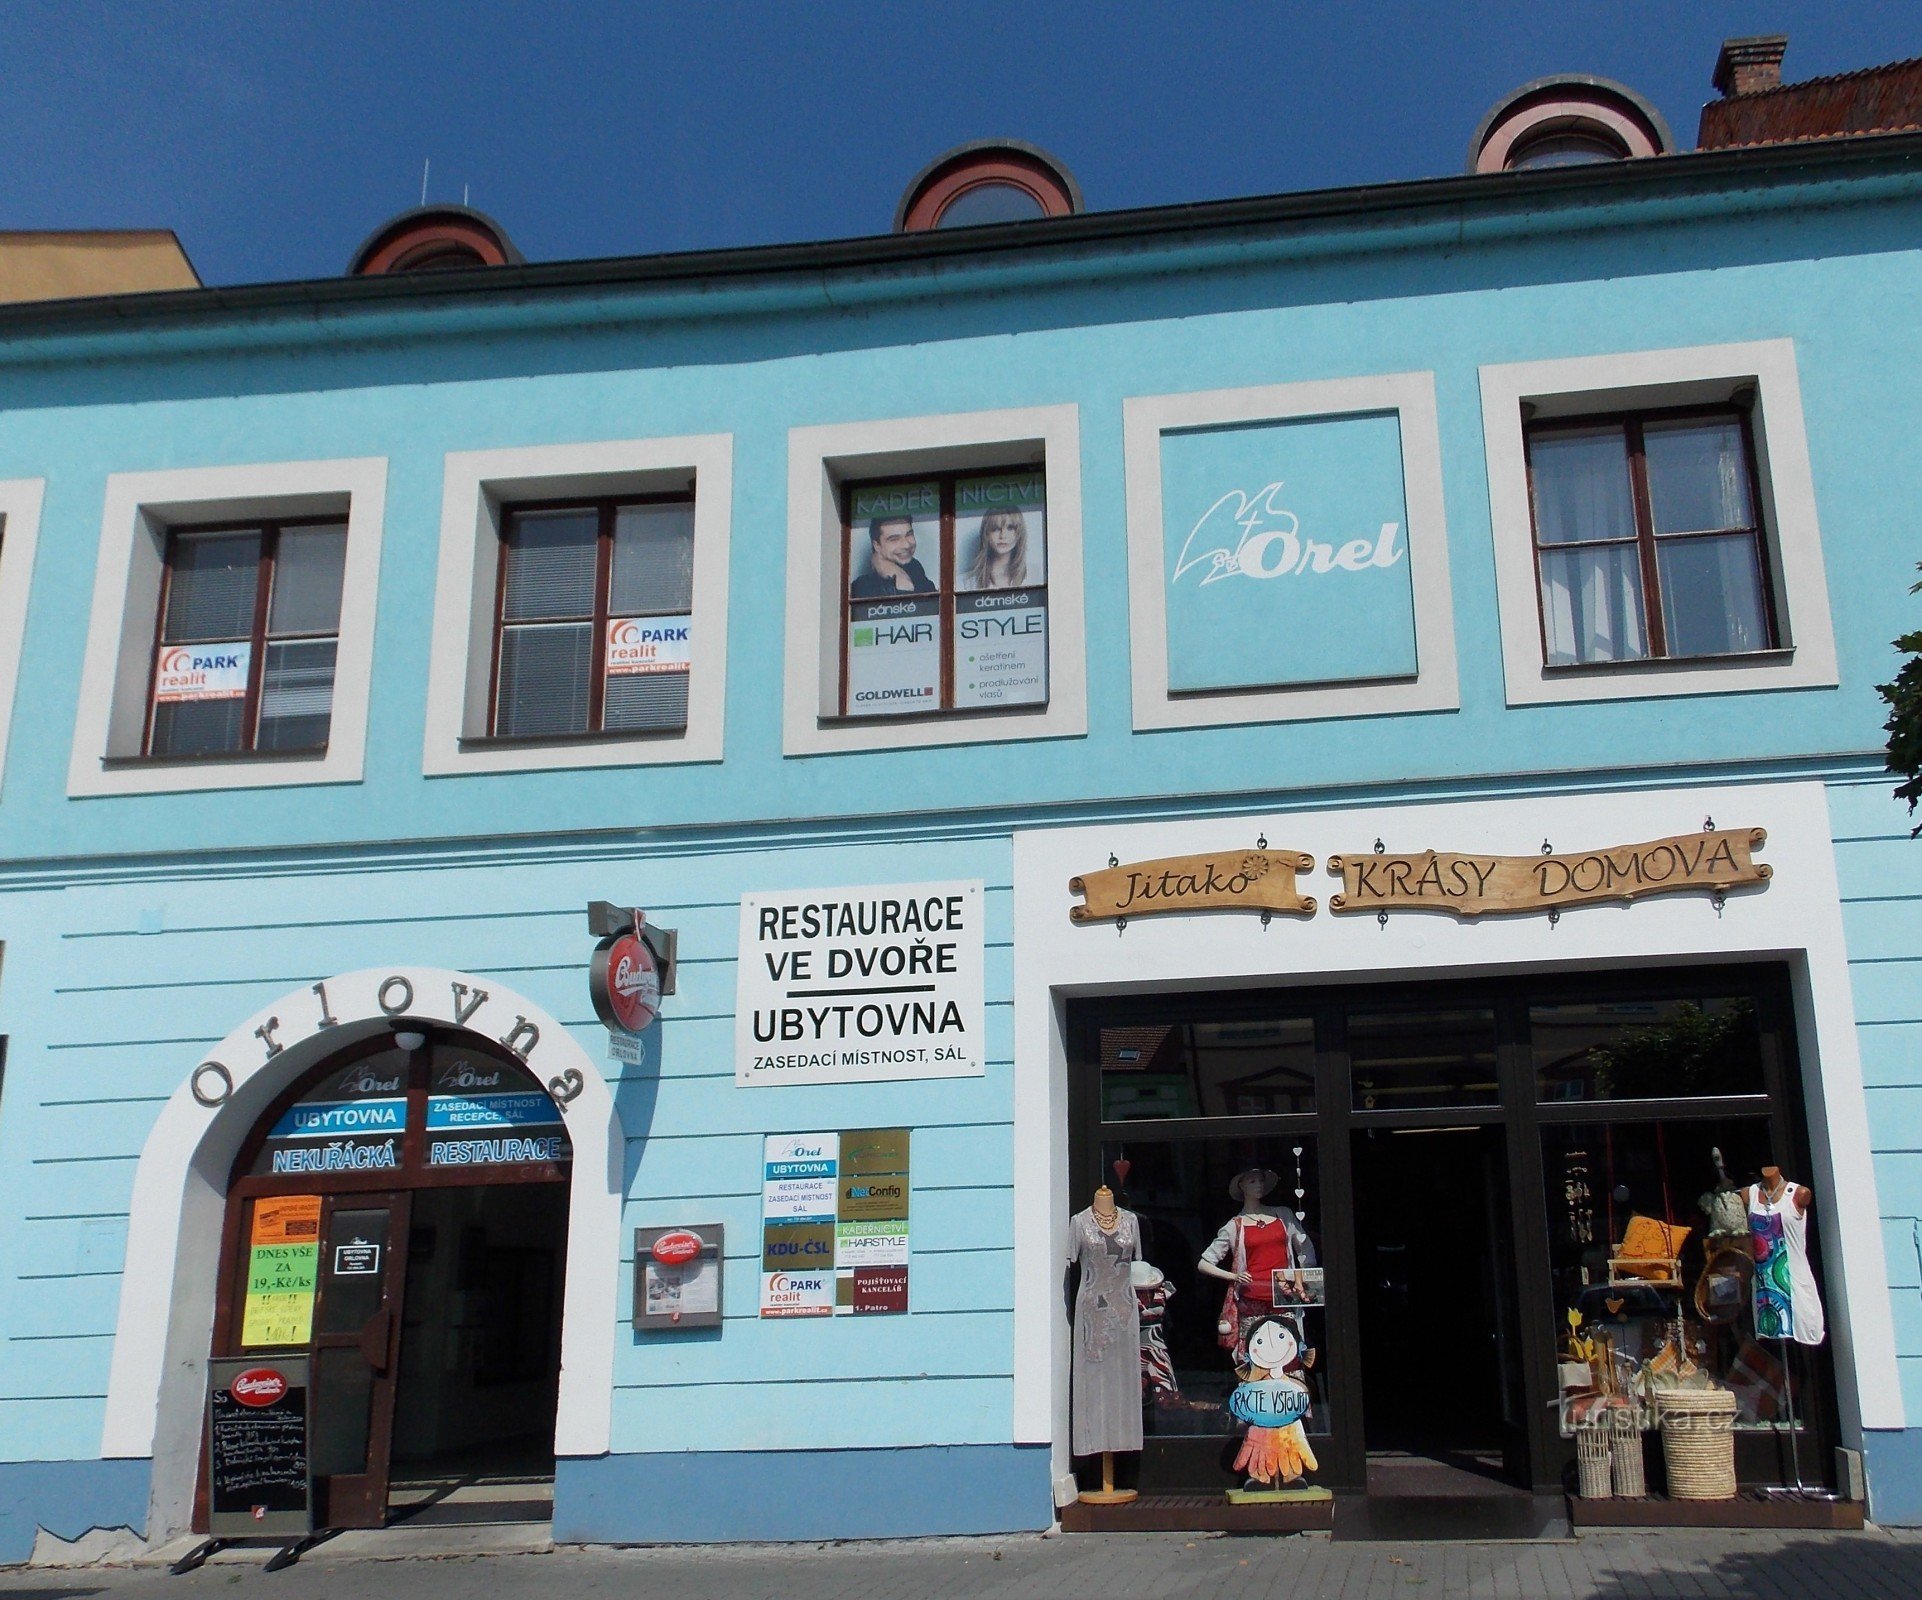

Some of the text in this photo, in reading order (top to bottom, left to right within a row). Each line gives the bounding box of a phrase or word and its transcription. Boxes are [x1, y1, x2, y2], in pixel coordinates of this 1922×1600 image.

[857, 486, 934, 514] KADEŘ
[1239, 522, 1404, 579] Orel
[975, 593, 1029, 608] dámské
[867, 602, 916, 618] pánské
[642, 628, 689, 643] PARK
[875, 614, 1042, 646] HAIR STYLE
[611, 644, 657, 659] realit
[979, 649, 1017, 662] ošetření
[192, 655, 239, 670] PARK
[979, 661, 1026, 673] keratinem
[162, 671, 207, 686] realit
[855, 687, 924, 702] GOLDWELL
[979, 689, 1003, 699] vlasů
[1350, 838, 1739, 898] KRÁSY DOMOVA
[1116, 863, 1260, 909] Jitako
[759, 896, 964, 941] RESTAURACE
[764, 936, 958, 982] VE DVOŘE
[753, 1000, 966, 1043] UBYTOVNA
[191, 974, 584, 1112] Orlovna
[753, 1044, 967, 1070] ZASEDACÍ MÍSTNOST, SÁL
[359, 1076, 400, 1093] Orel
[459, 1071, 500, 1088] Orel
[489, 1096, 543, 1110] MÍSTNOST
[293, 1108, 398, 1128] UBYTOVNA
[449, 1110, 503, 1122] RECEPCE,
[272, 1138, 397, 1173] NEKUŘÁCKÁ
[430, 1137, 562, 1165] RESTAURACE
[793, 1146, 822, 1157] Orel
[772, 1162, 829, 1175] UBYTOVNA
[778, 1181, 823, 1191] RESTAURACE
[792, 1202, 809, 1213] SÁL
[767, 1238, 830, 1256] KDU-ČSL
[848, 1236, 906, 1248] HAIRSTYLE
[256, 1246, 313, 1260] DNES VŠE
[276, 1262, 292, 1273] ZA
[253, 1275, 313, 1291] 19,-Kč/ks
[790, 1279, 822, 1291] PARK
[857, 1276, 907, 1286] POJIŠŤOVACÍ
[861, 1284, 903, 1294] KANCELÁŘ
[770, 1291, 801, 1303] realit
[864, 1304, 889, 1312] Patro
